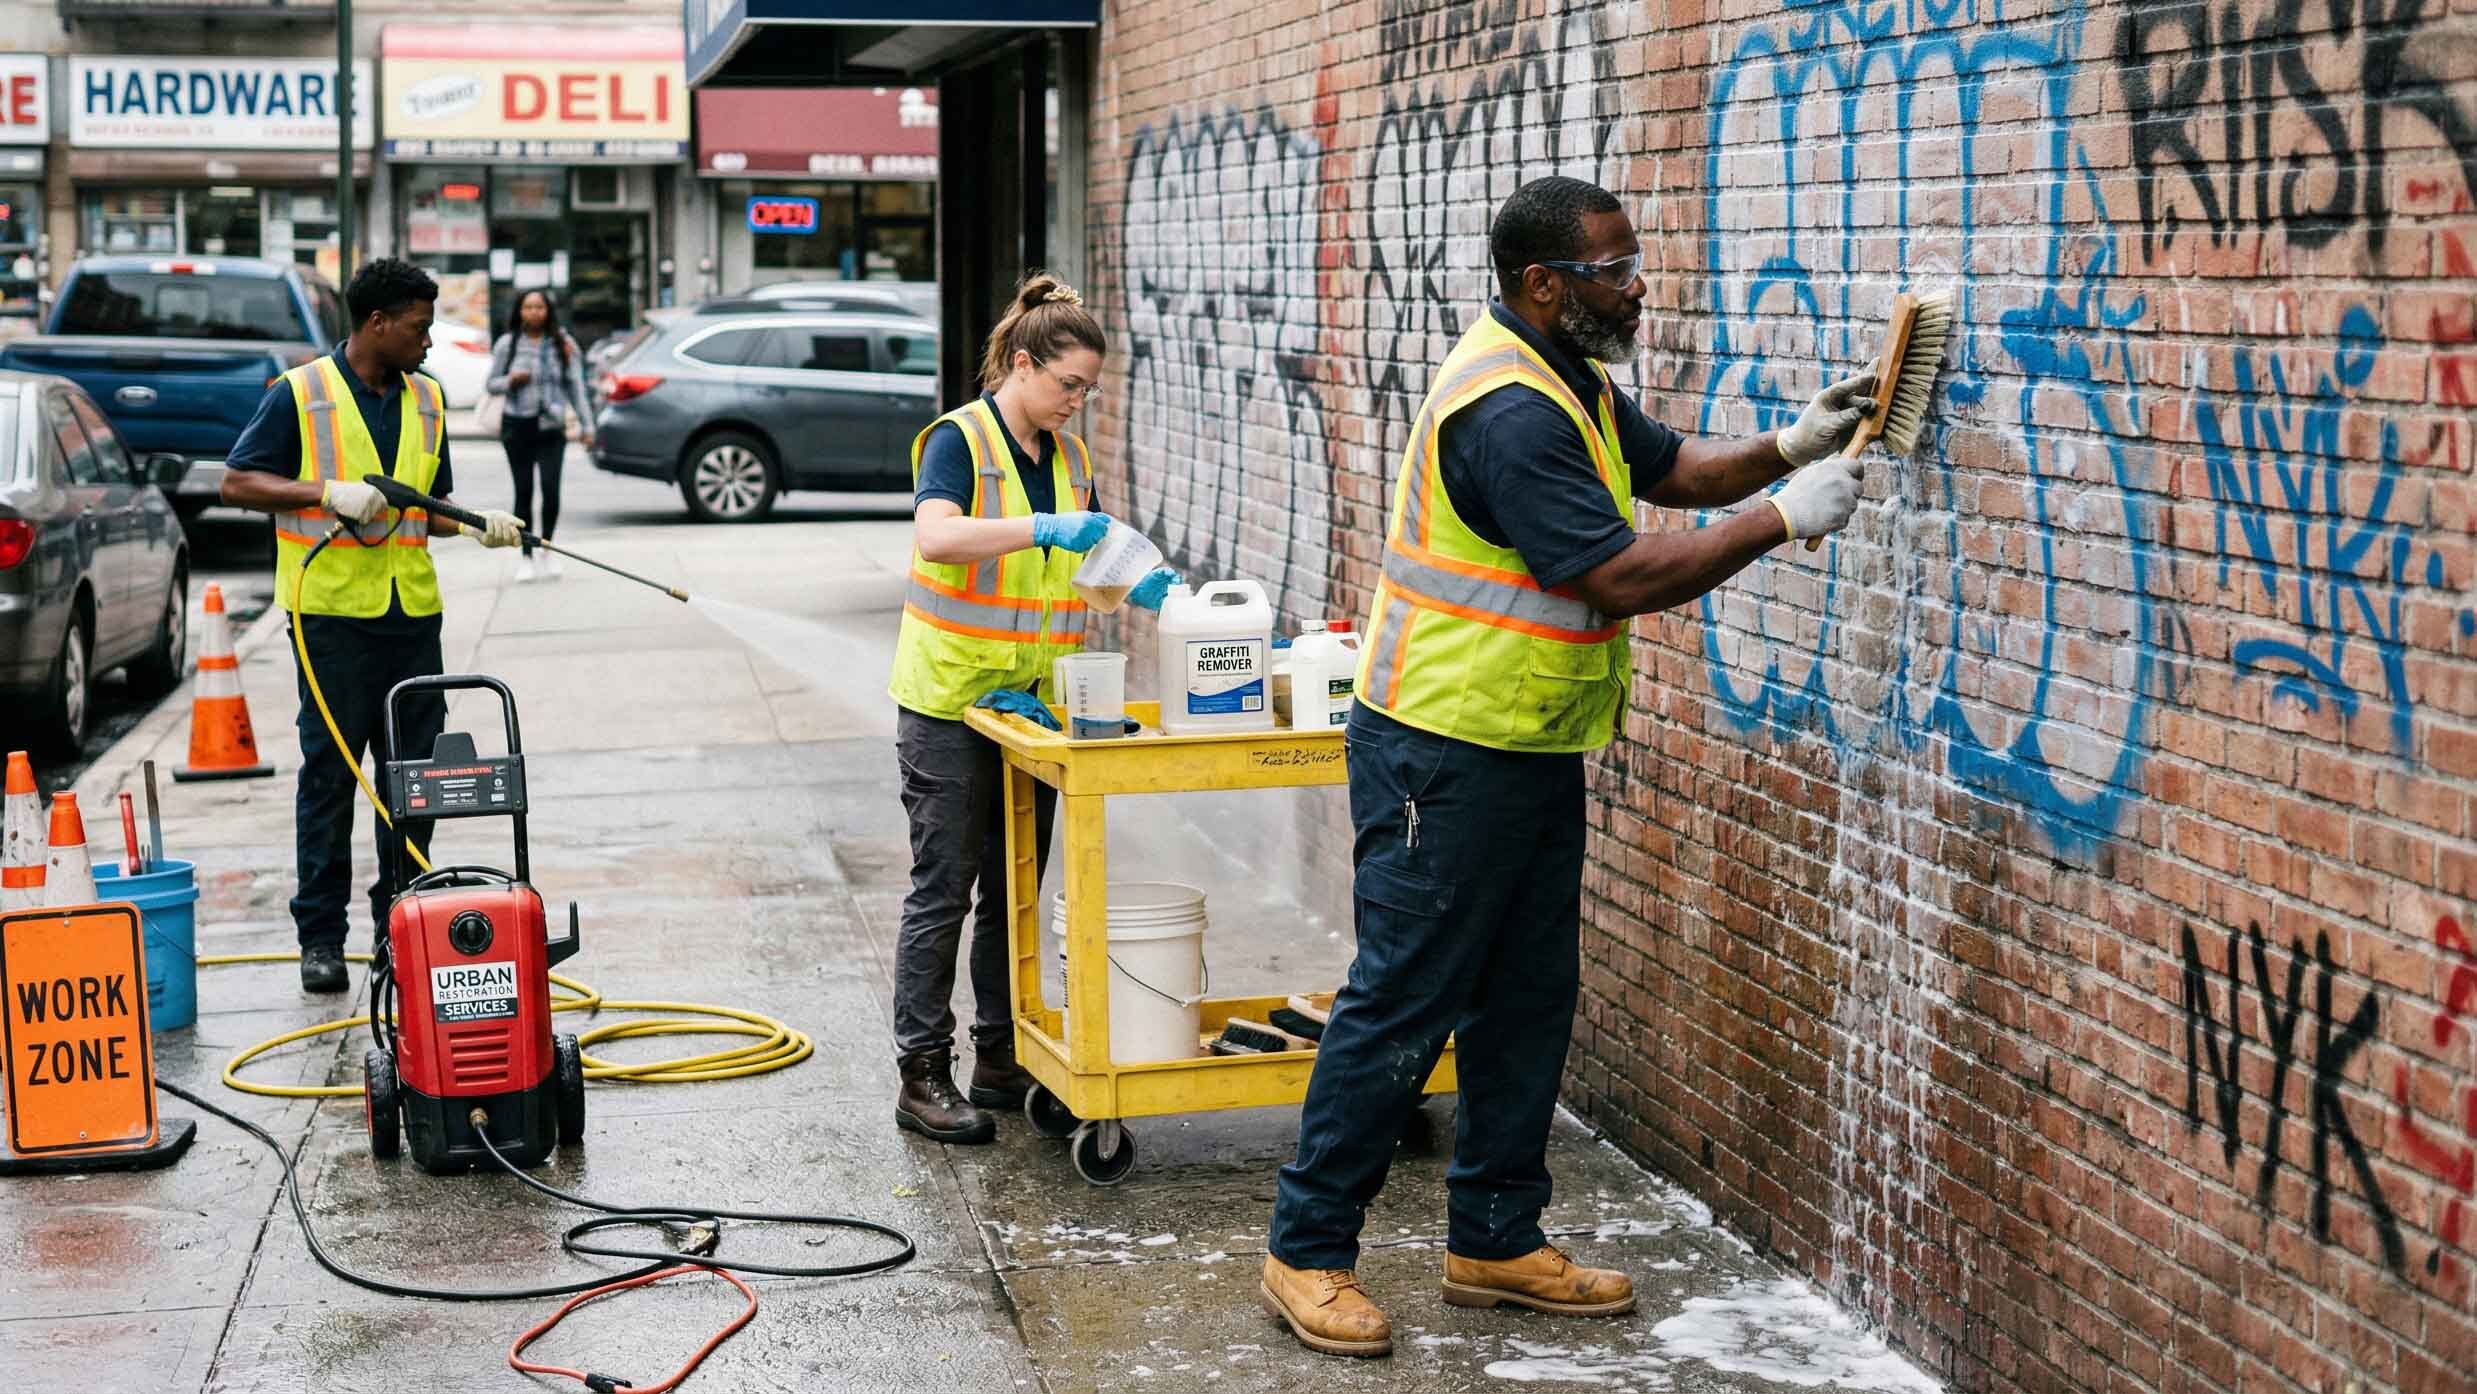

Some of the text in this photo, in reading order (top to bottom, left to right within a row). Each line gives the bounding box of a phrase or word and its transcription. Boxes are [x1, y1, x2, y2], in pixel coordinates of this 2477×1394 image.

[0, 75, 37, 125] E
[503, 73, 667, 122] DELI
[1197, 658, 1252, 672] REMOVER
[1200, 646, 1250, 659] GRAFFITI
[17, 974, 128, 1024] WORK
[437, 967, 513, 990] URBAN
[445, 1000, 508, 1016] SERVICES
[28, 1036, 130, 1086] ZONE
[2181, 919, 2406, 1277] NYK
